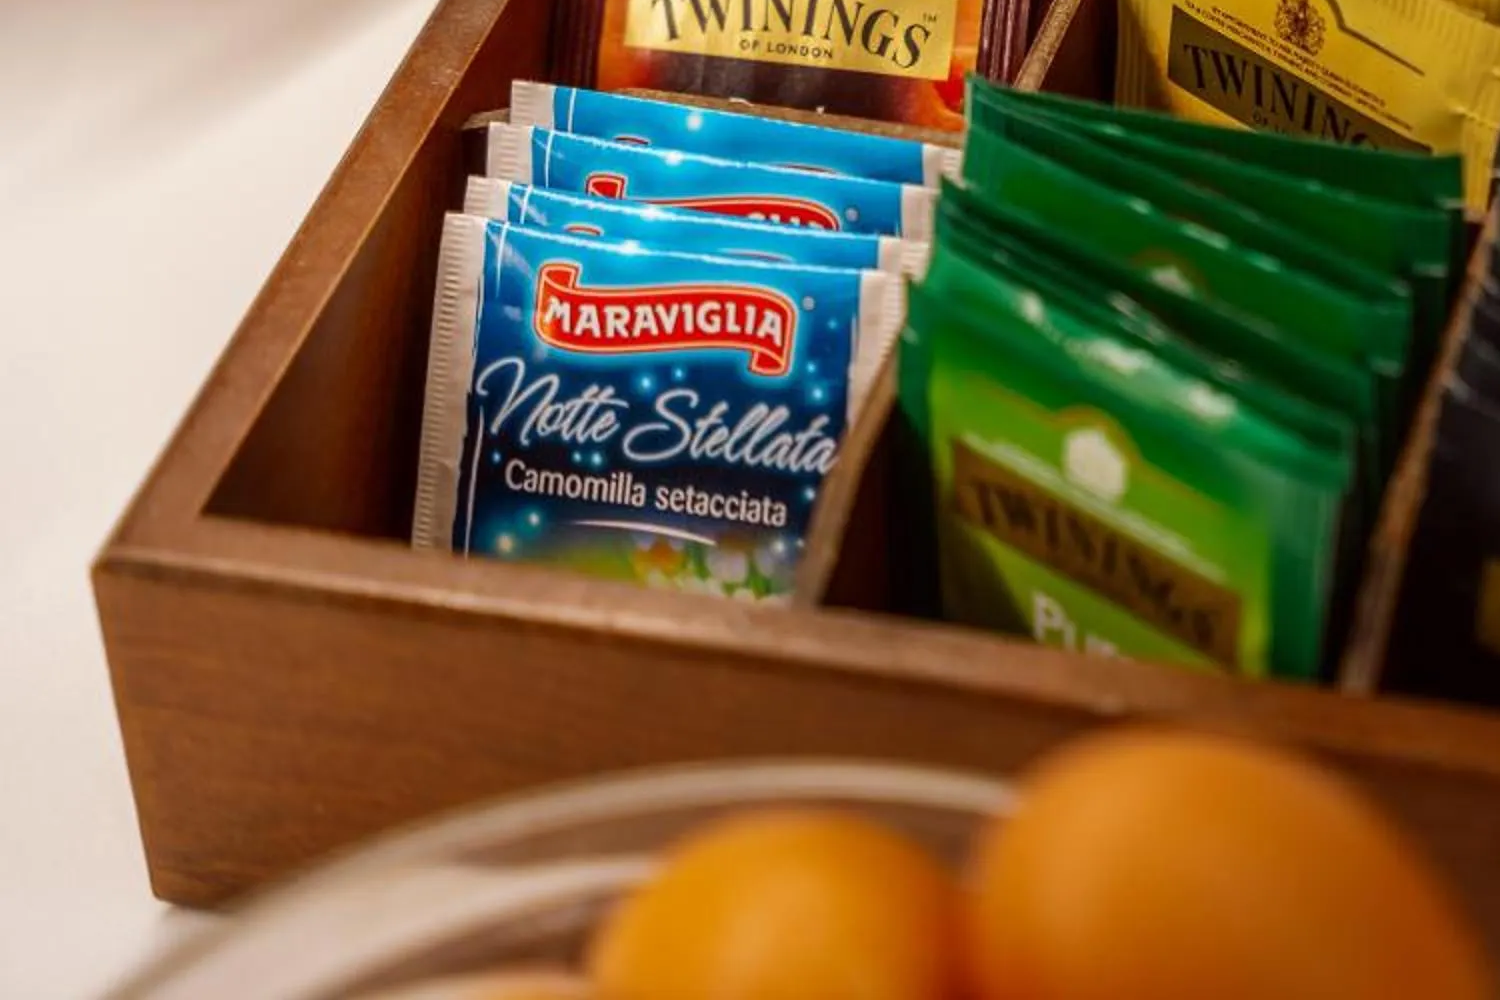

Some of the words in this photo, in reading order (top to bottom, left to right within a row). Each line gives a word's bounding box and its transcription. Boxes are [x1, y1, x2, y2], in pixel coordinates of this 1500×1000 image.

[739, 39, 760, 51] OF
[767, 42, 833, 59] LONDON
[1184, 43, 1378, 150] TWININ
[543, 300, 786, 346] MARAVIGLIA
[476, 356, 630, 447] Notte
[622, 389, 842, 475] Stellata
[504, 458, 646, 507] Camomilla
[655, 481, 788, 528] setacciata
